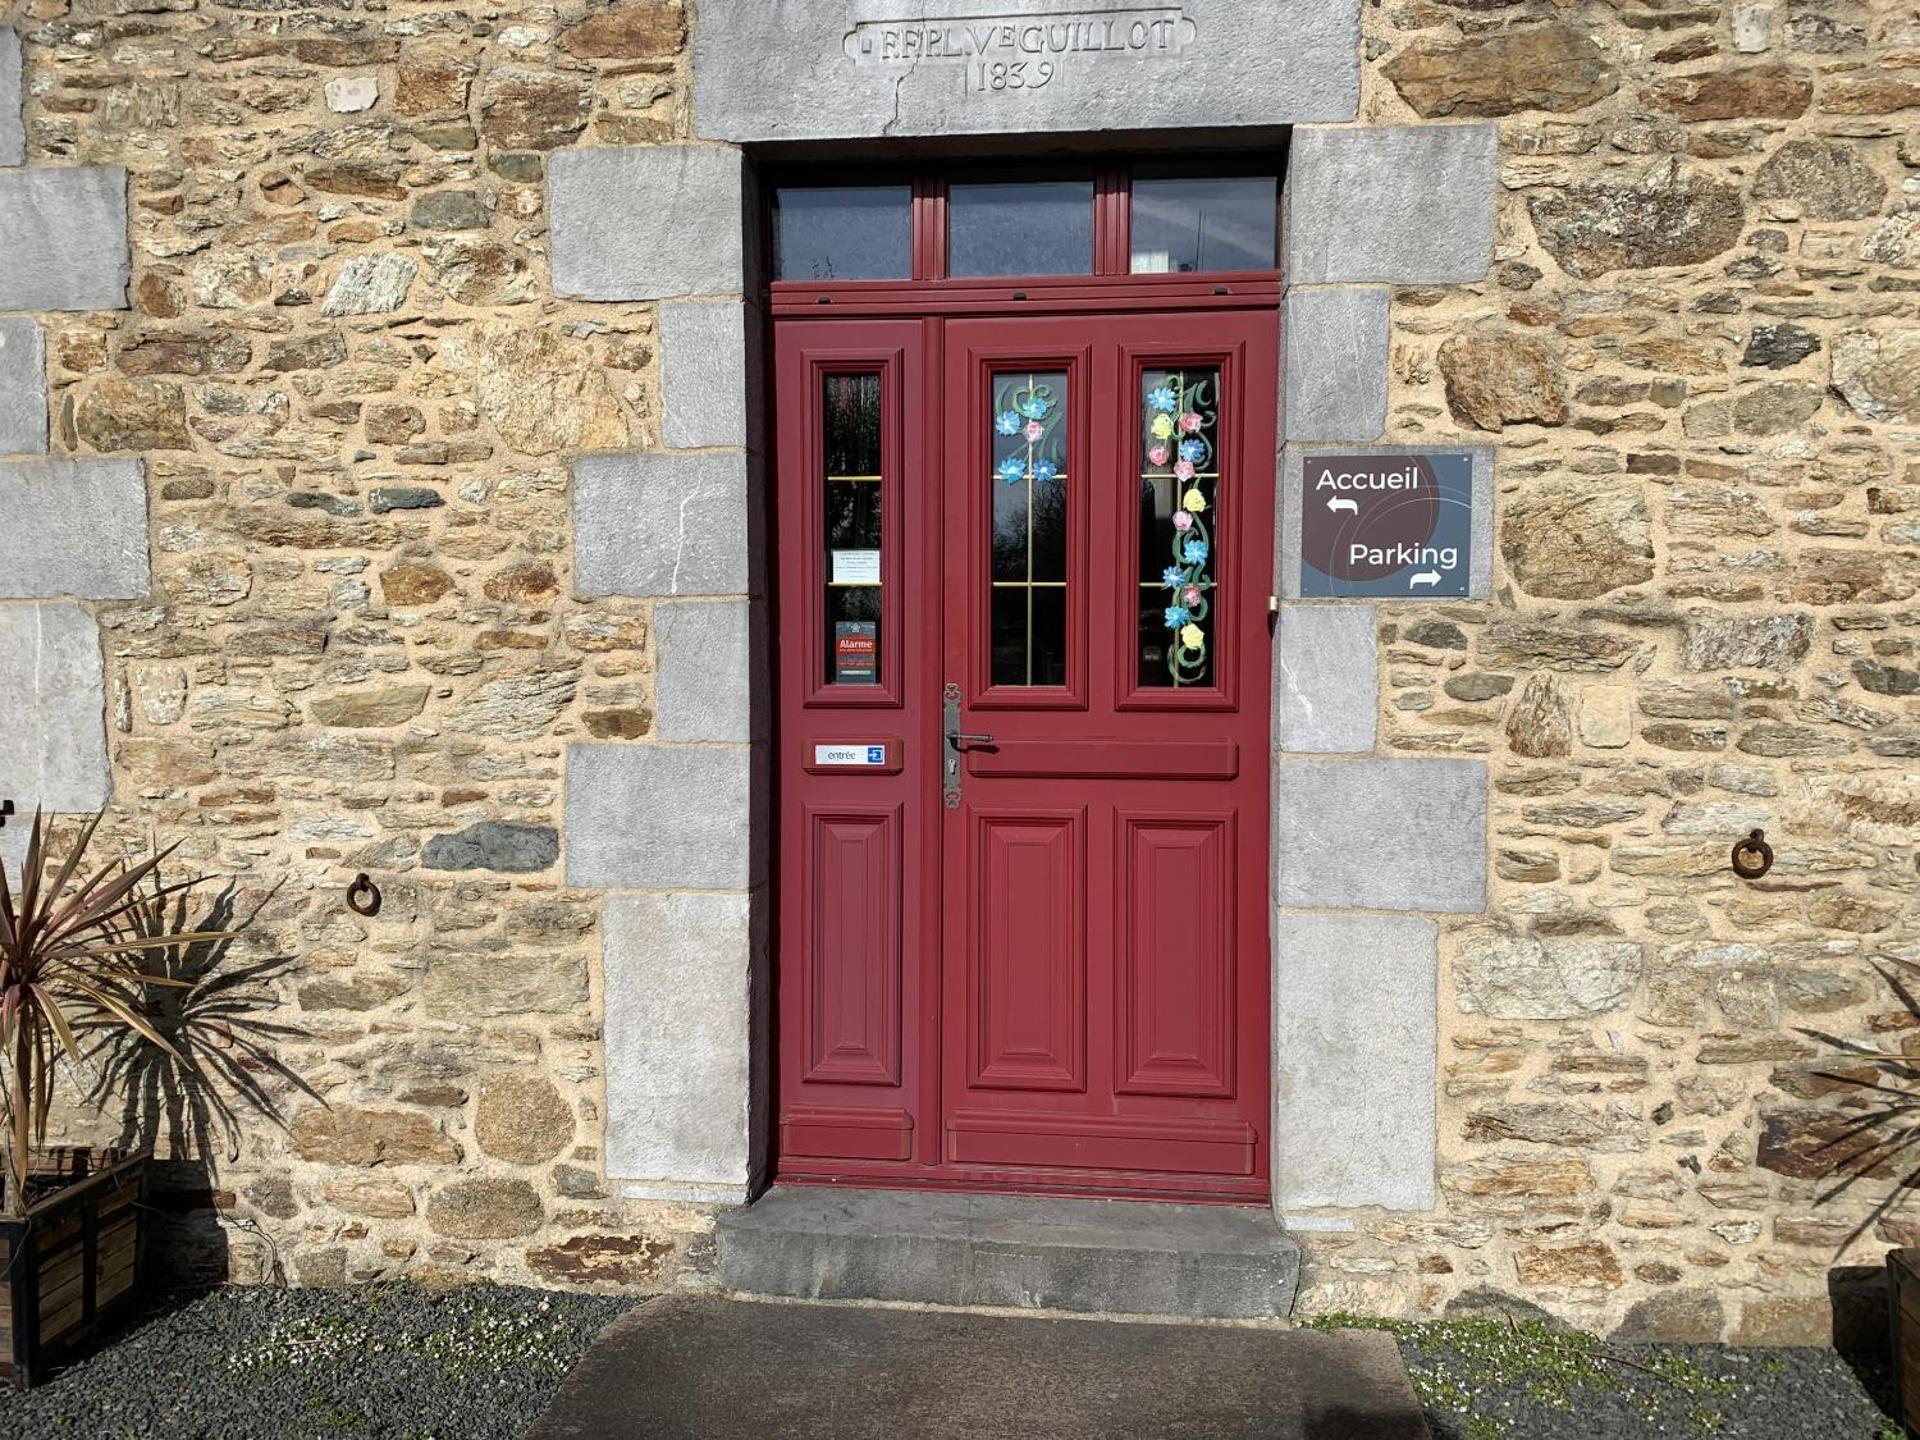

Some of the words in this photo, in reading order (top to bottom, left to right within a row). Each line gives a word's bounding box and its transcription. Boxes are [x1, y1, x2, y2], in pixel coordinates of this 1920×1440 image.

[977, 61, 1054, 91] 1839
[1315, 467, 1418, 490] Accueil
[1350, 542, 1458, 570] Parking
[839, 639, 873, 649] Alarme
[827, 750, 856, 760] entrée
